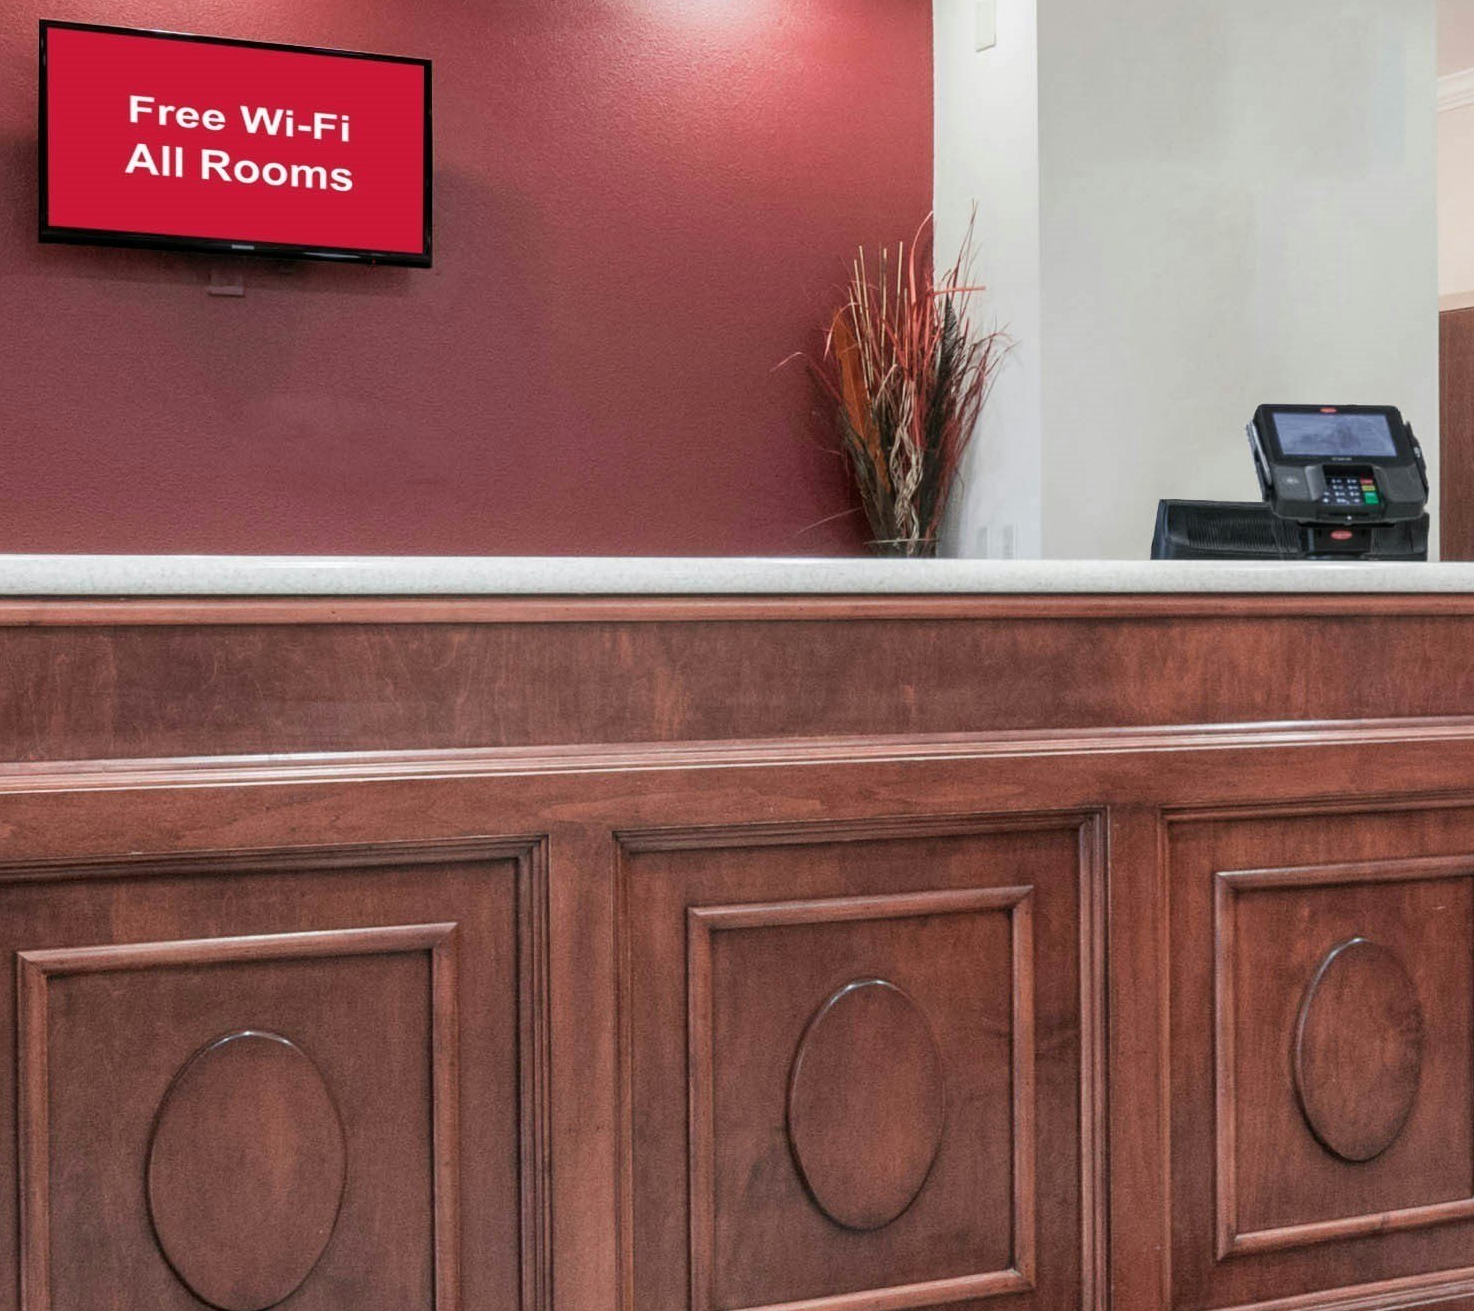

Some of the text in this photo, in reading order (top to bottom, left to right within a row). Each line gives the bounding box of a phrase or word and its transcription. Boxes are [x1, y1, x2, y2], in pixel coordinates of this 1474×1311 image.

[129, 95, 351, 143] Free Wi-Fi
[125, 143, 354, 192] All Rooms
